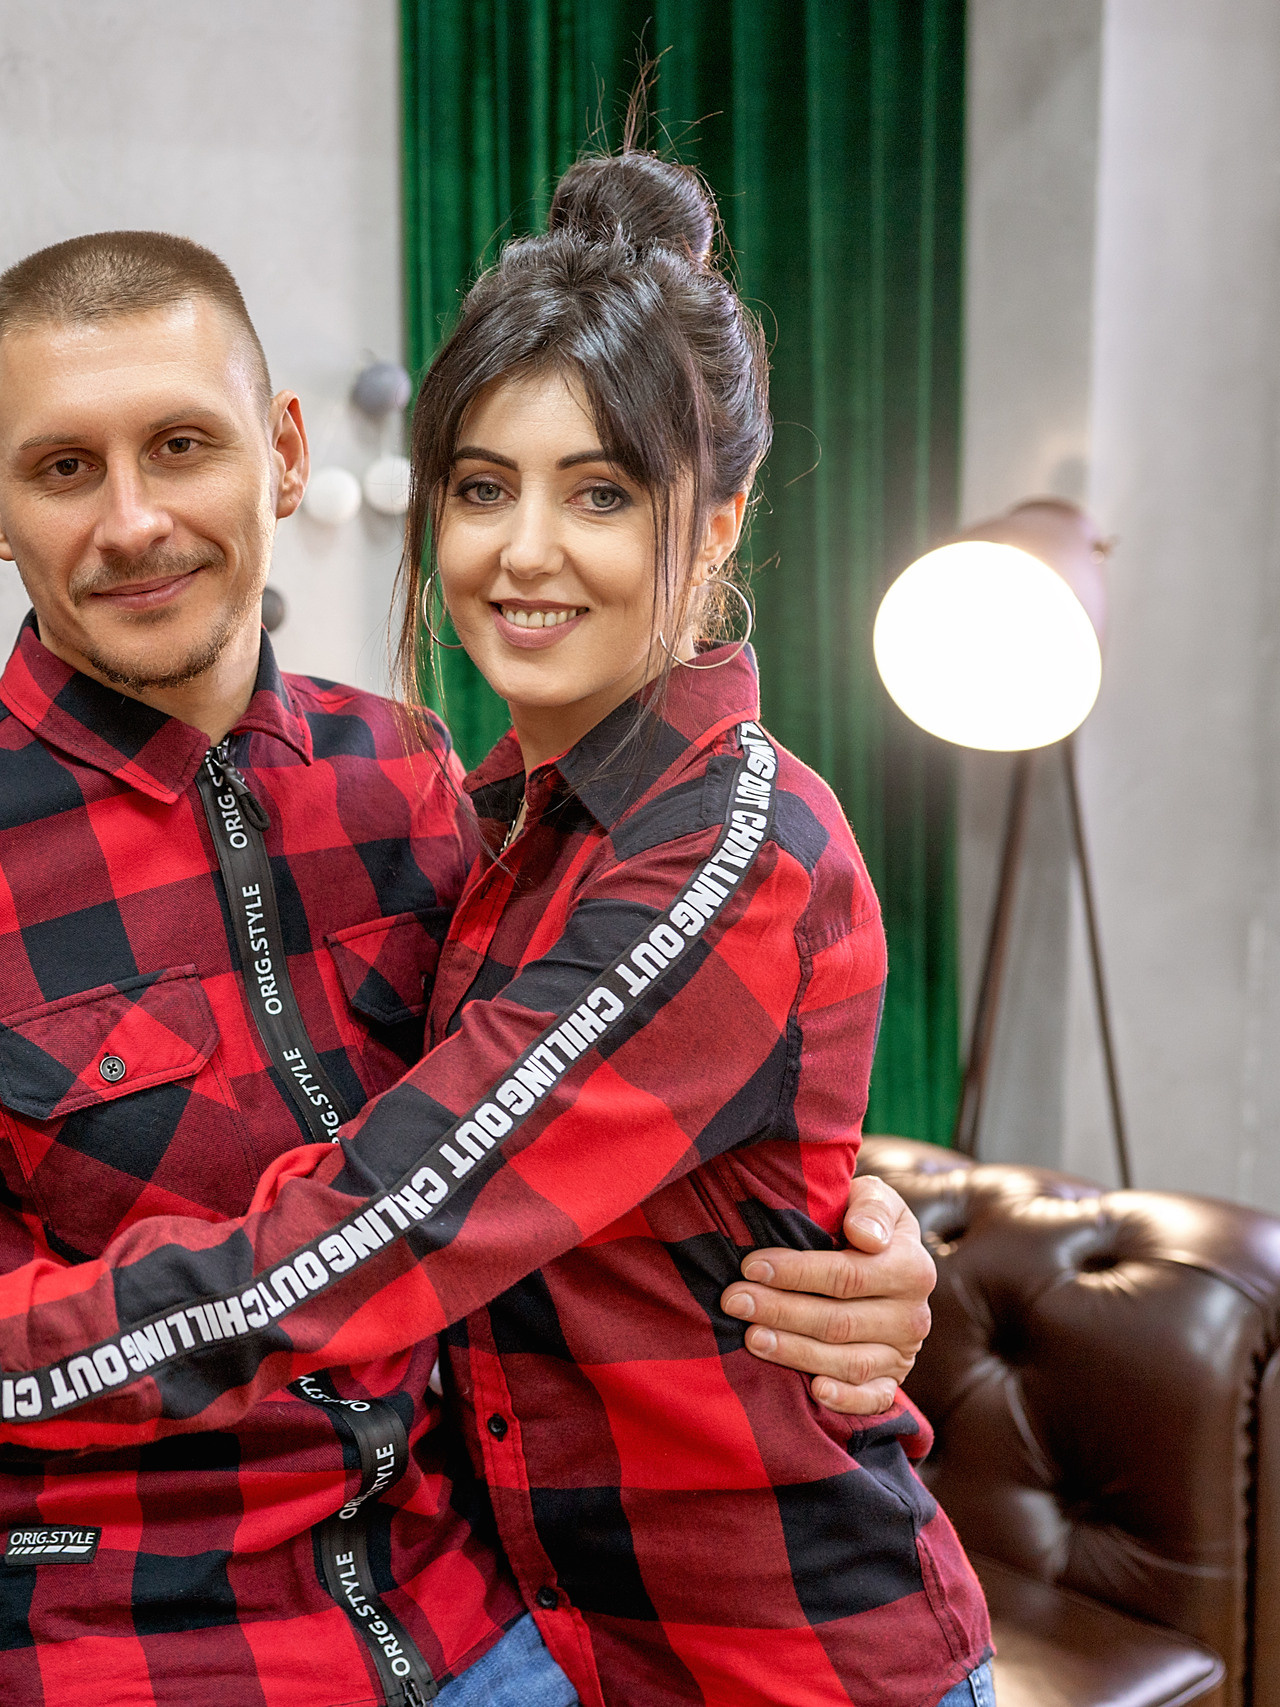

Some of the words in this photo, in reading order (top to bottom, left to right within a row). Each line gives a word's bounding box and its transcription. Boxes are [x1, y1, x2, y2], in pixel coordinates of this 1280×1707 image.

[735, 771, 772, 811] OUT
[669, 809, 768, 937] CHILLING
[242, 883, 283, 1016] ORIG.STYLE
[615, 923, 685, 997] OUT
[495, 986, 625, 1116] CHILLING
[439, 1102, 514, 1179] OUT
[50, 1343, 128, 1410] OUT
[10, 1531, 96, 1545] ORIG.STYLE
[336, 1551, 411, 1677] ORIG.STYLE
